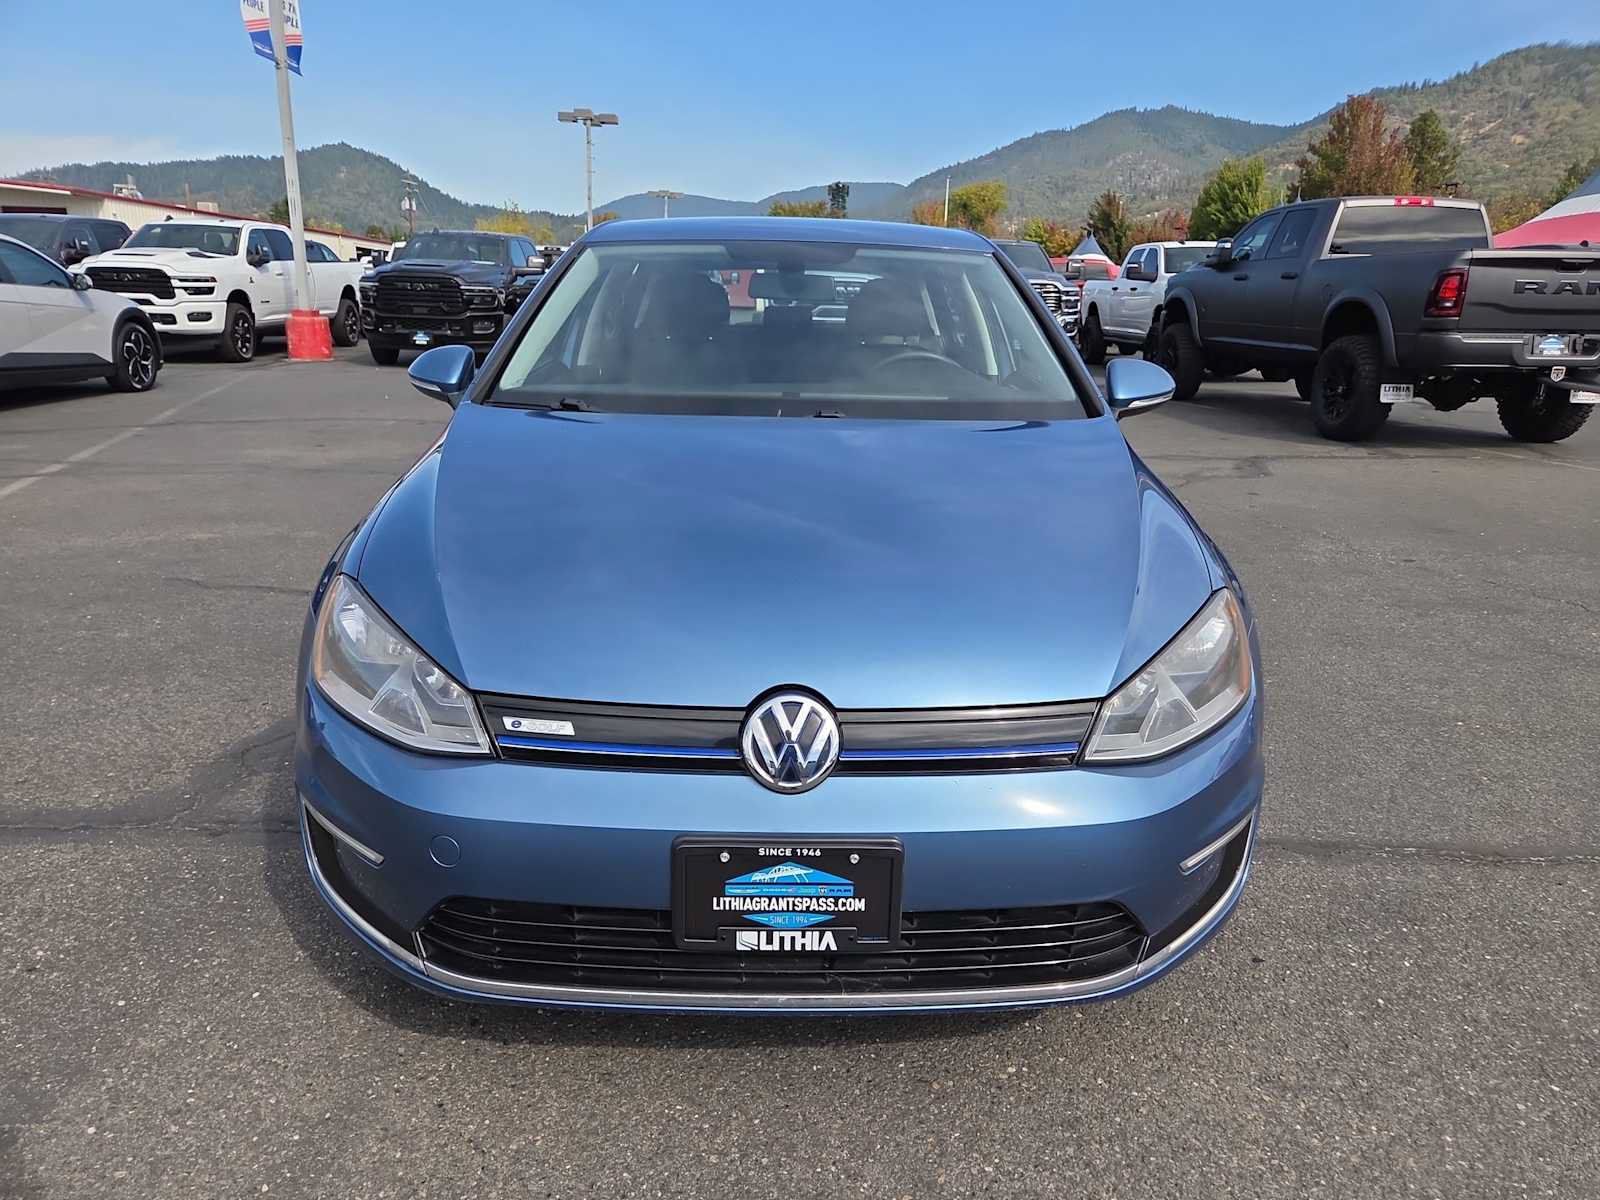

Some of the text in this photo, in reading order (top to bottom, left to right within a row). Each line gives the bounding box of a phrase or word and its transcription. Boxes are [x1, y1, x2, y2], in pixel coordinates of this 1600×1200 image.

[758, 847, 822, 857] SINCE 1946
[712, 896, 866, 912] LITHIAGRANTSPASS.COM
[769, 914, 788, 925] SINCE
[759, 930, 838, 951] LITHIA
